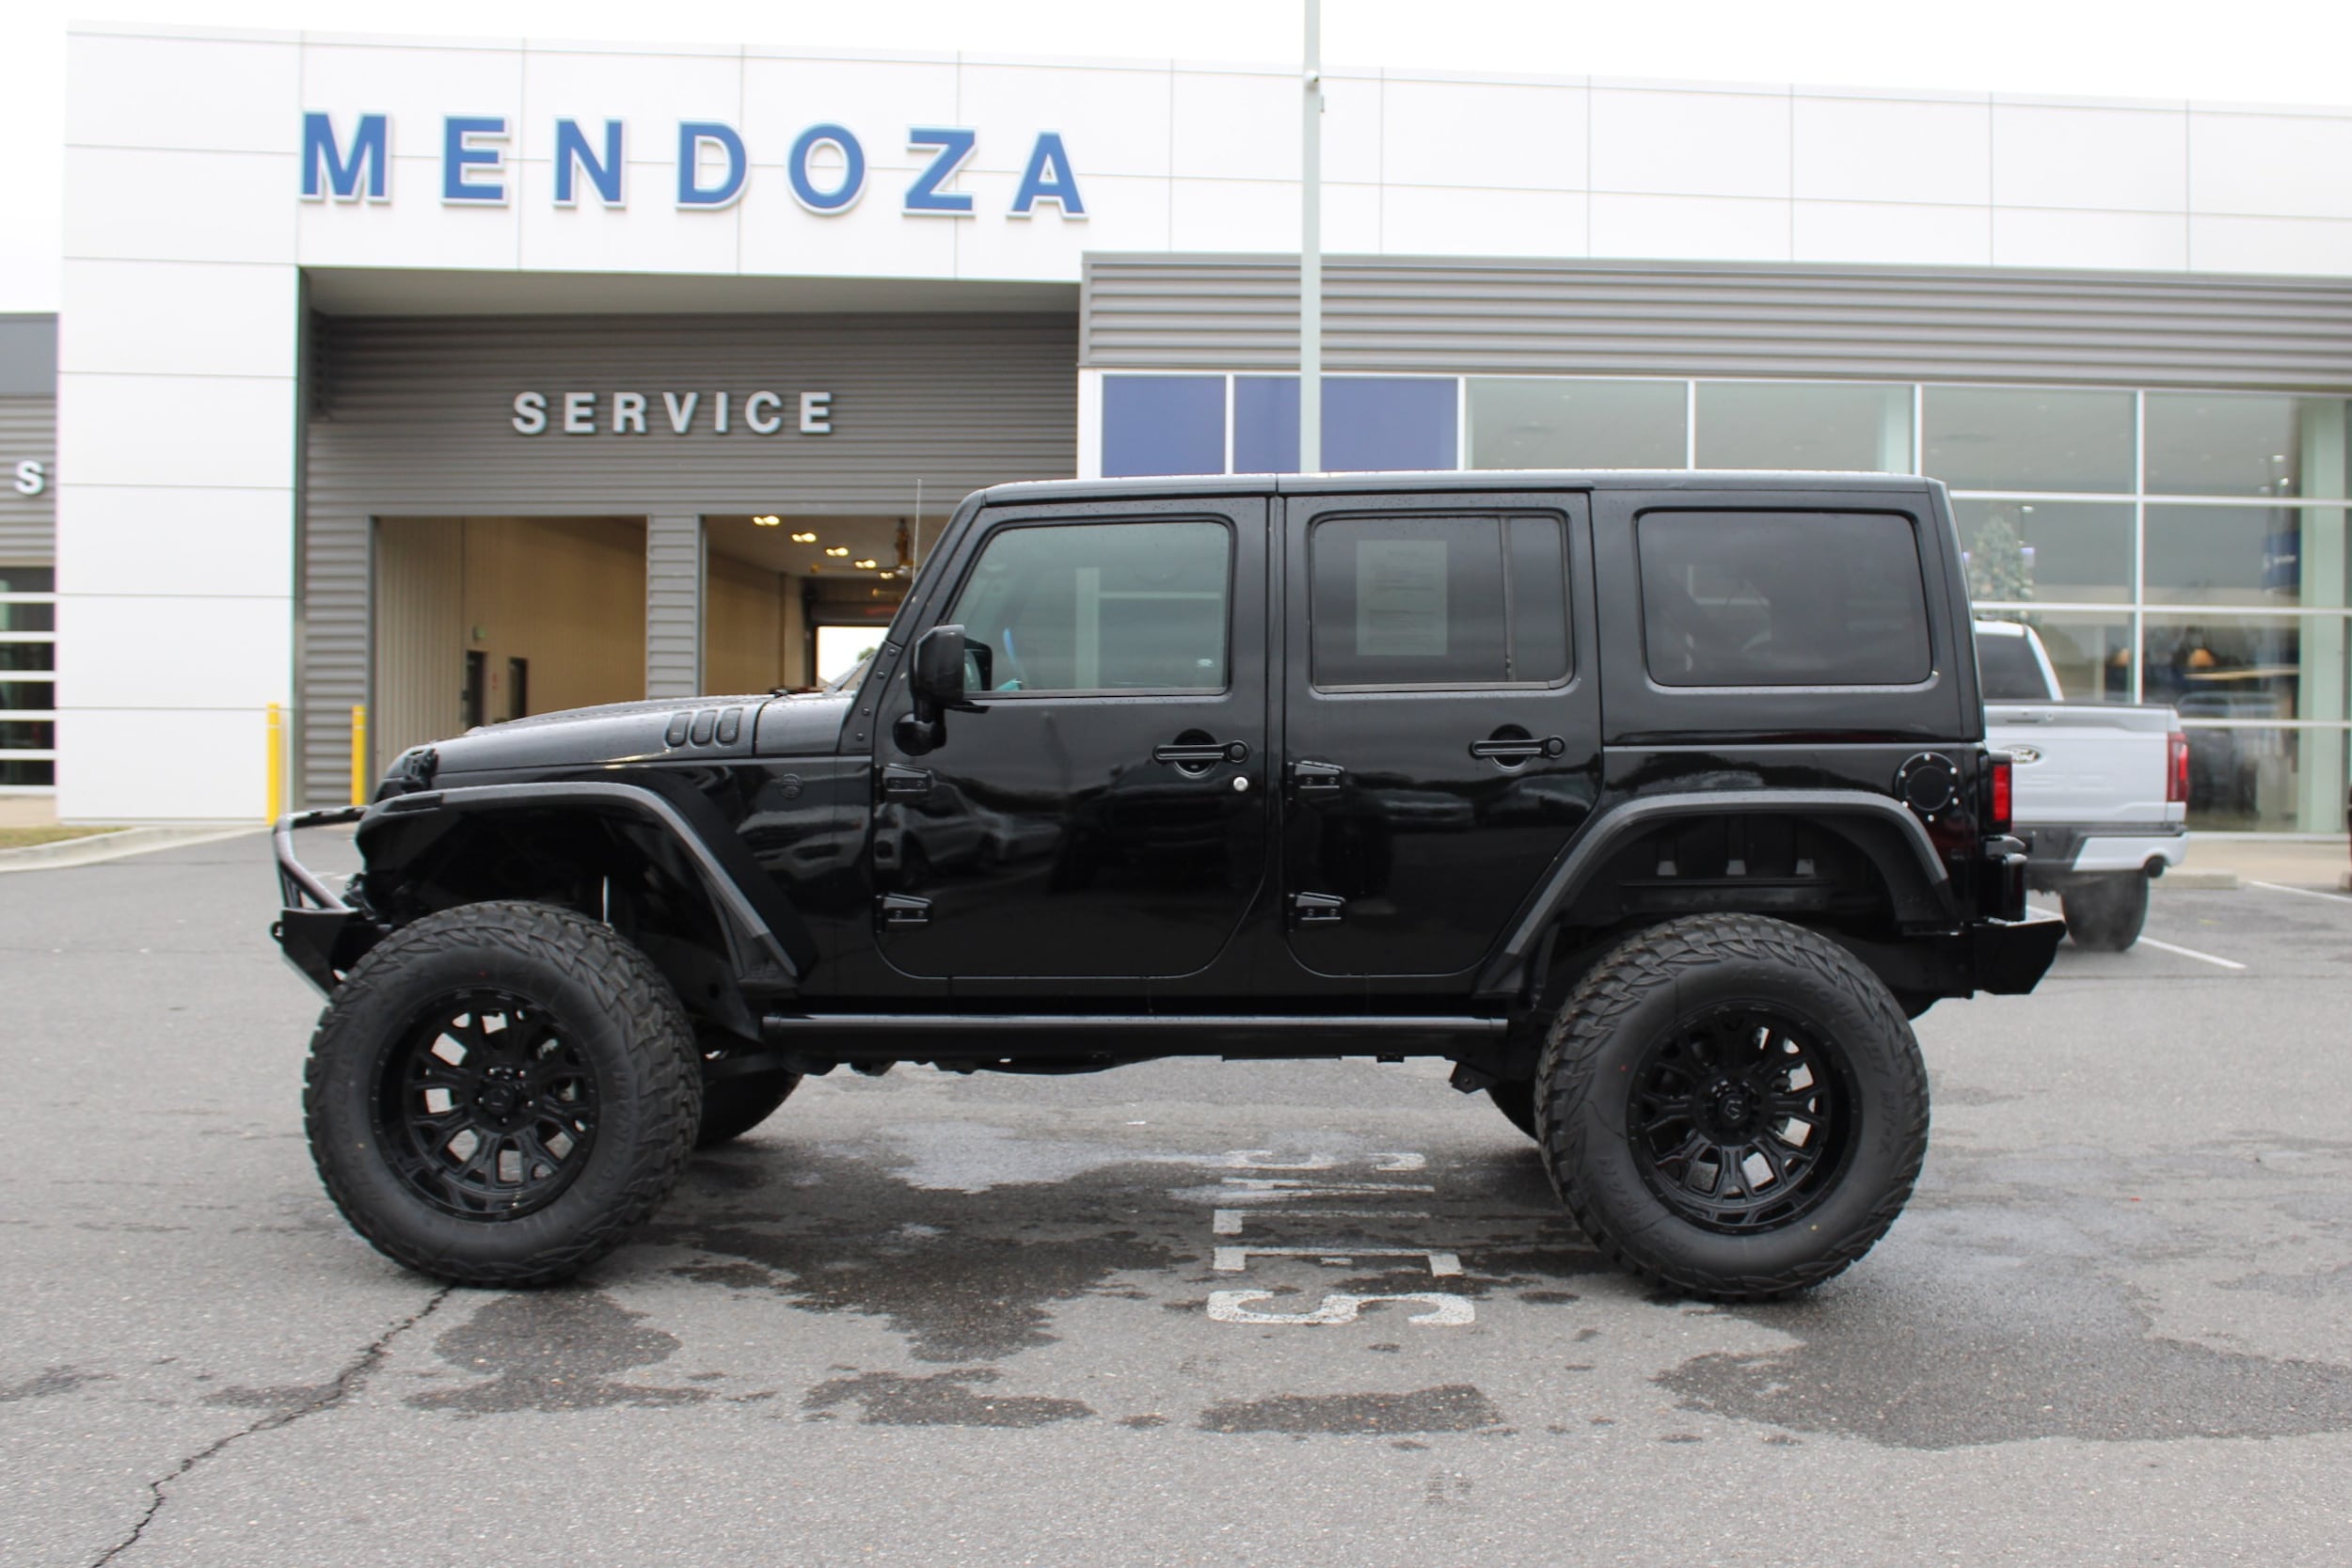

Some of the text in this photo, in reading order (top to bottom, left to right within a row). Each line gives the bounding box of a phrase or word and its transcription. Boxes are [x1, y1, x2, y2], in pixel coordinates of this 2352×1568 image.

[299, 110, 1091, 222] MENDOZA
[513, 390, 834, 436] SERVICE
[14, 459, 45, 497] S
